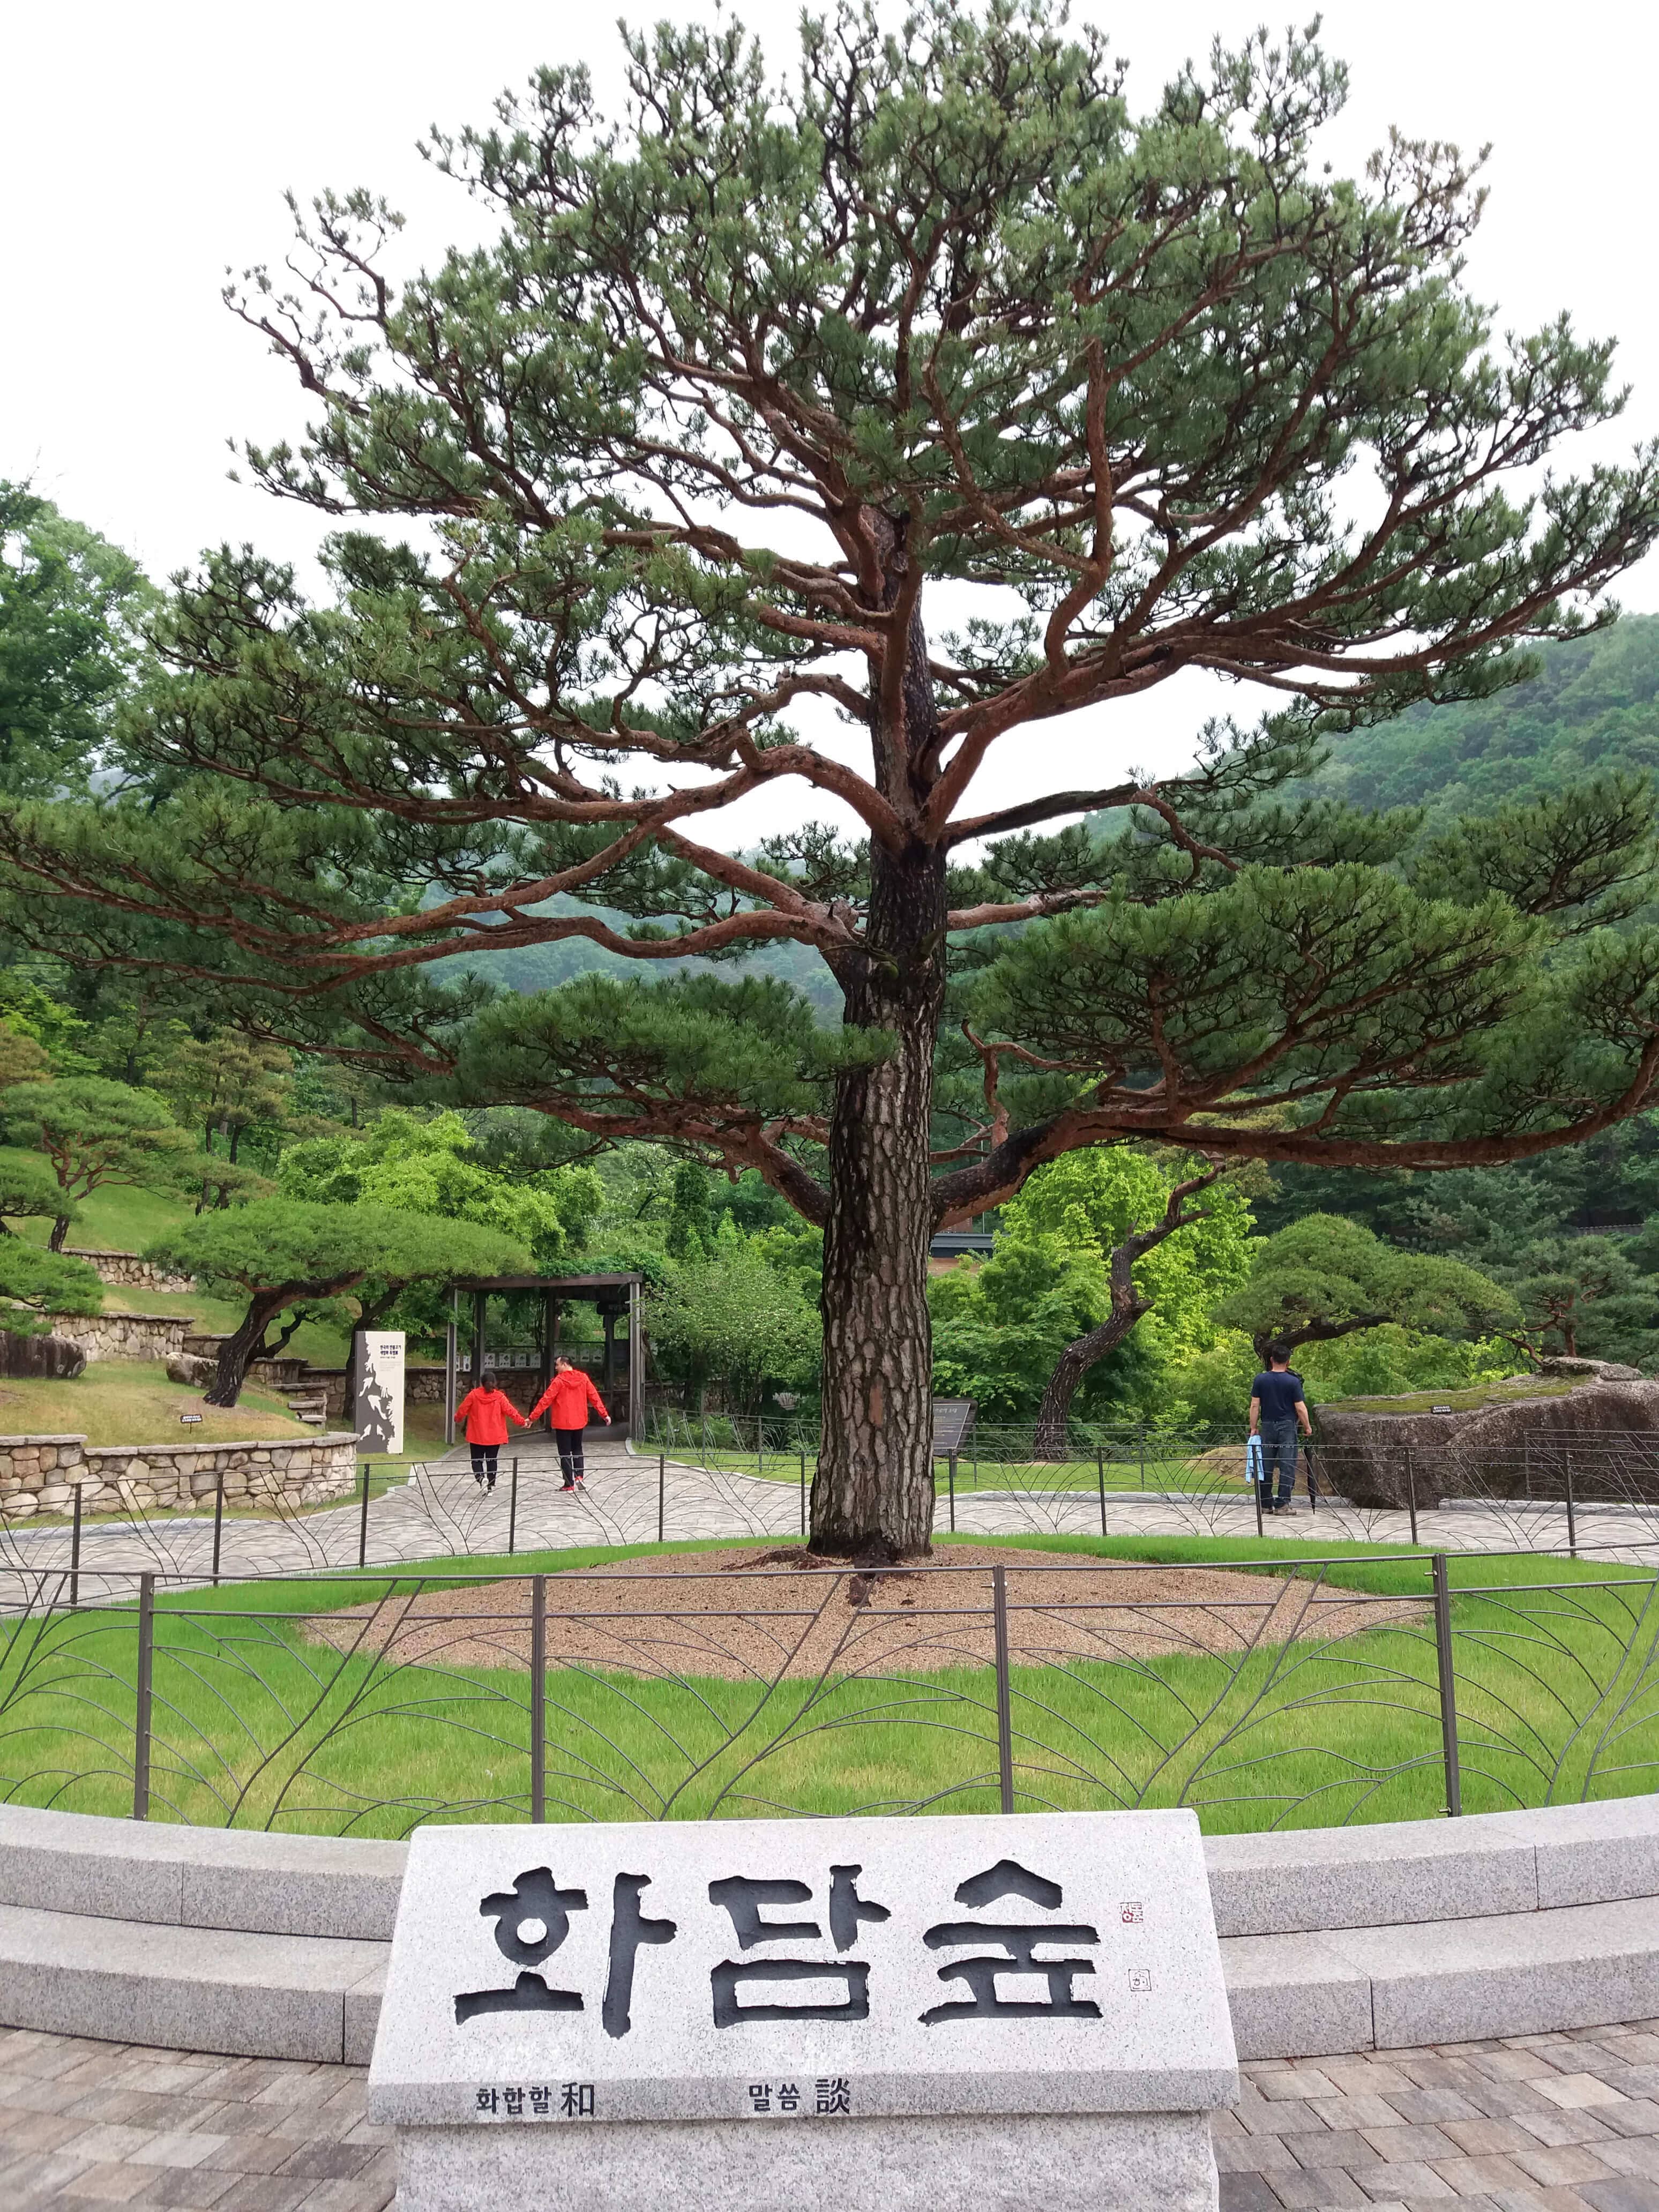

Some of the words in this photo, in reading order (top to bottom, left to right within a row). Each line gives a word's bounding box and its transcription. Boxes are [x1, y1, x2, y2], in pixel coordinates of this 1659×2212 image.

[454, 1859, 1103, 2039] 화담숲
[476, 2087, 552, 2115] 화합할
[561, 2082, 595, 2117] 和
[749, 2083, 801, 2112] 말씀
[814, 2078, 850, 2115] 談
